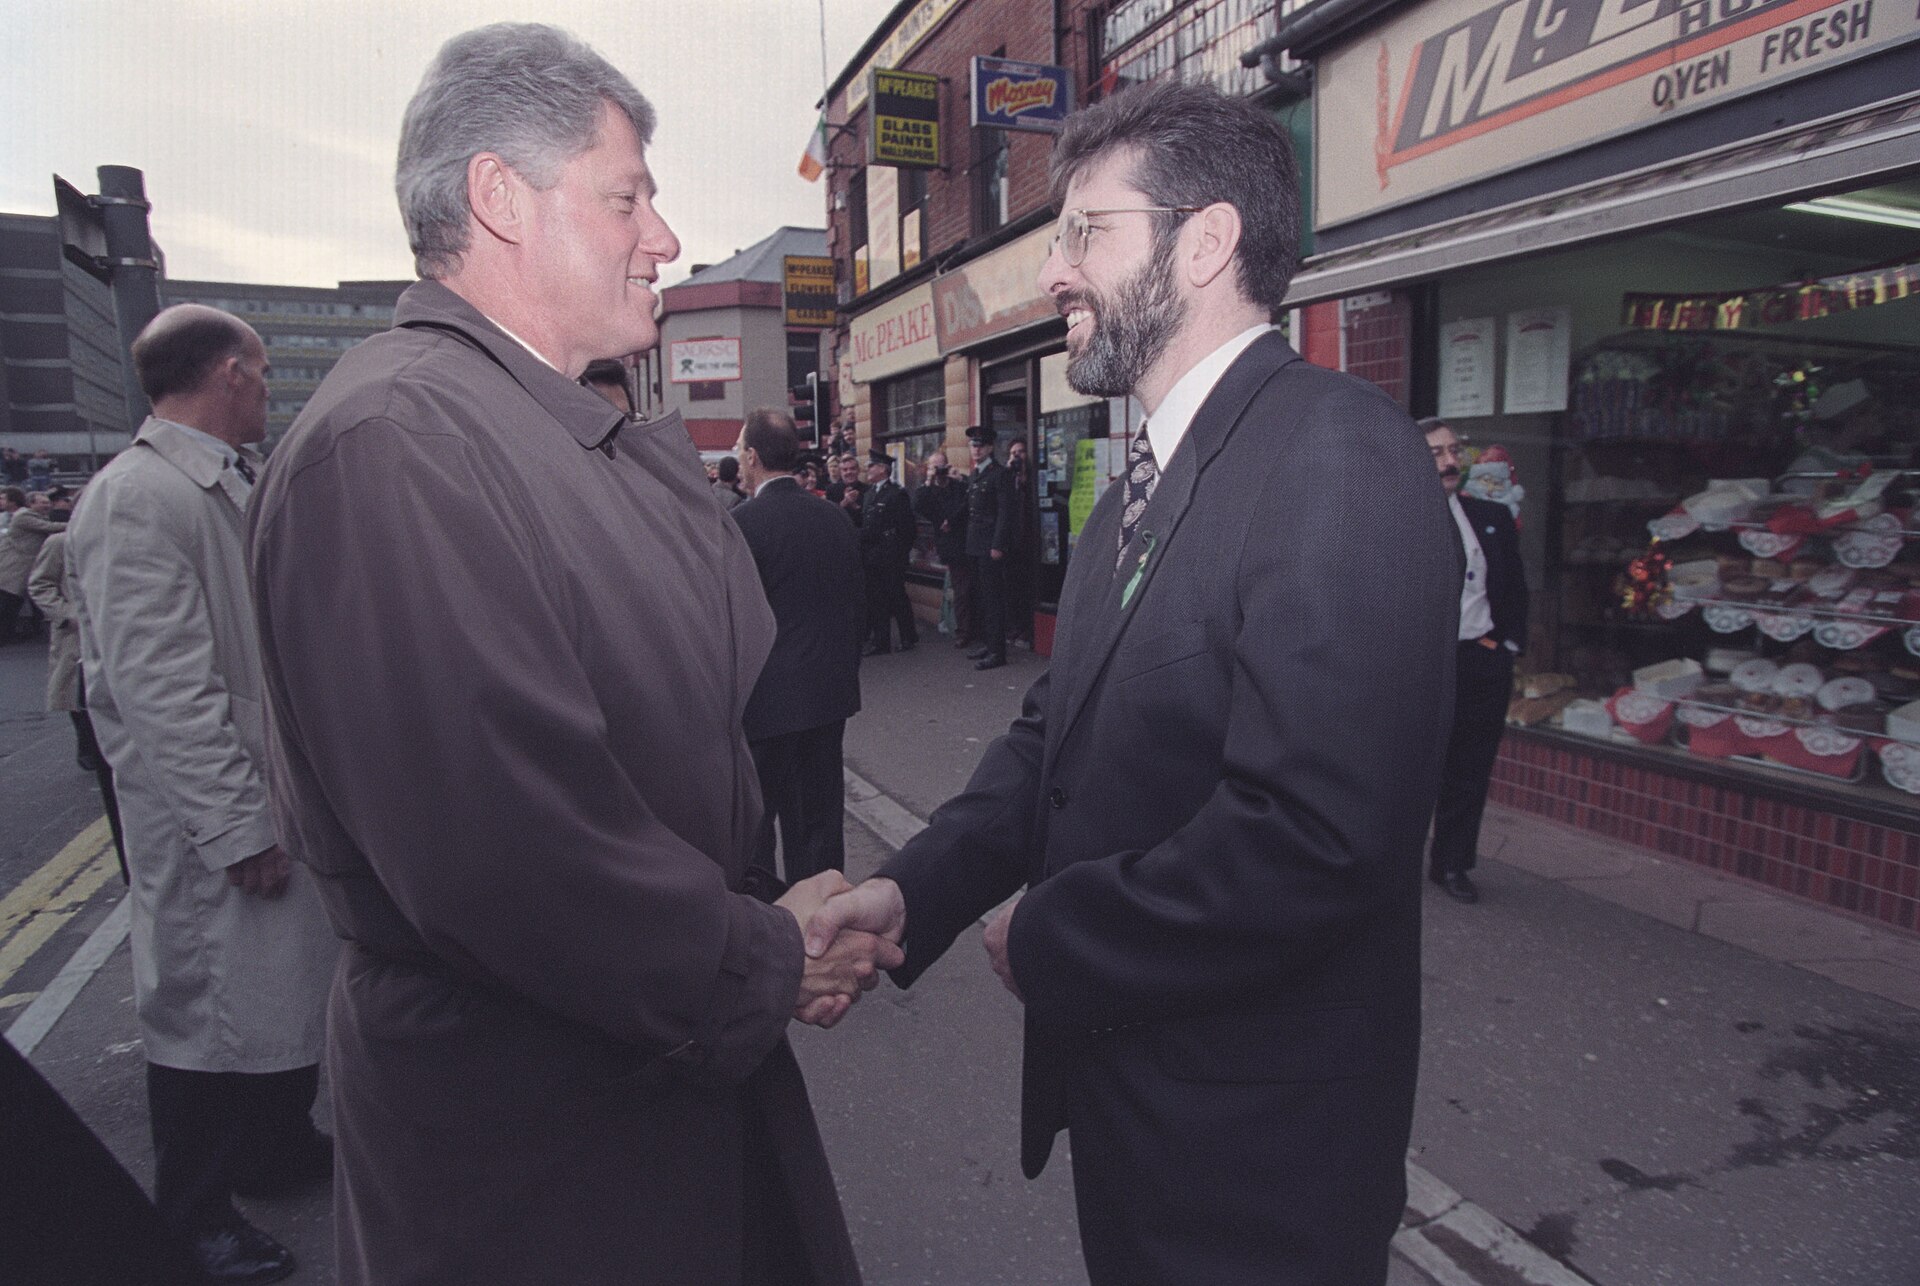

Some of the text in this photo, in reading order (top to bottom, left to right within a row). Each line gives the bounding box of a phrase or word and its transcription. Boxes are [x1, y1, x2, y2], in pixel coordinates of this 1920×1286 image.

[1652, 0, 1873, 107] OVEN FRESH
[882, 119, 931, 135] GLASS
[881, 131, 933, 149] PAINTS
[797, 308, 828, 319] CARDS
